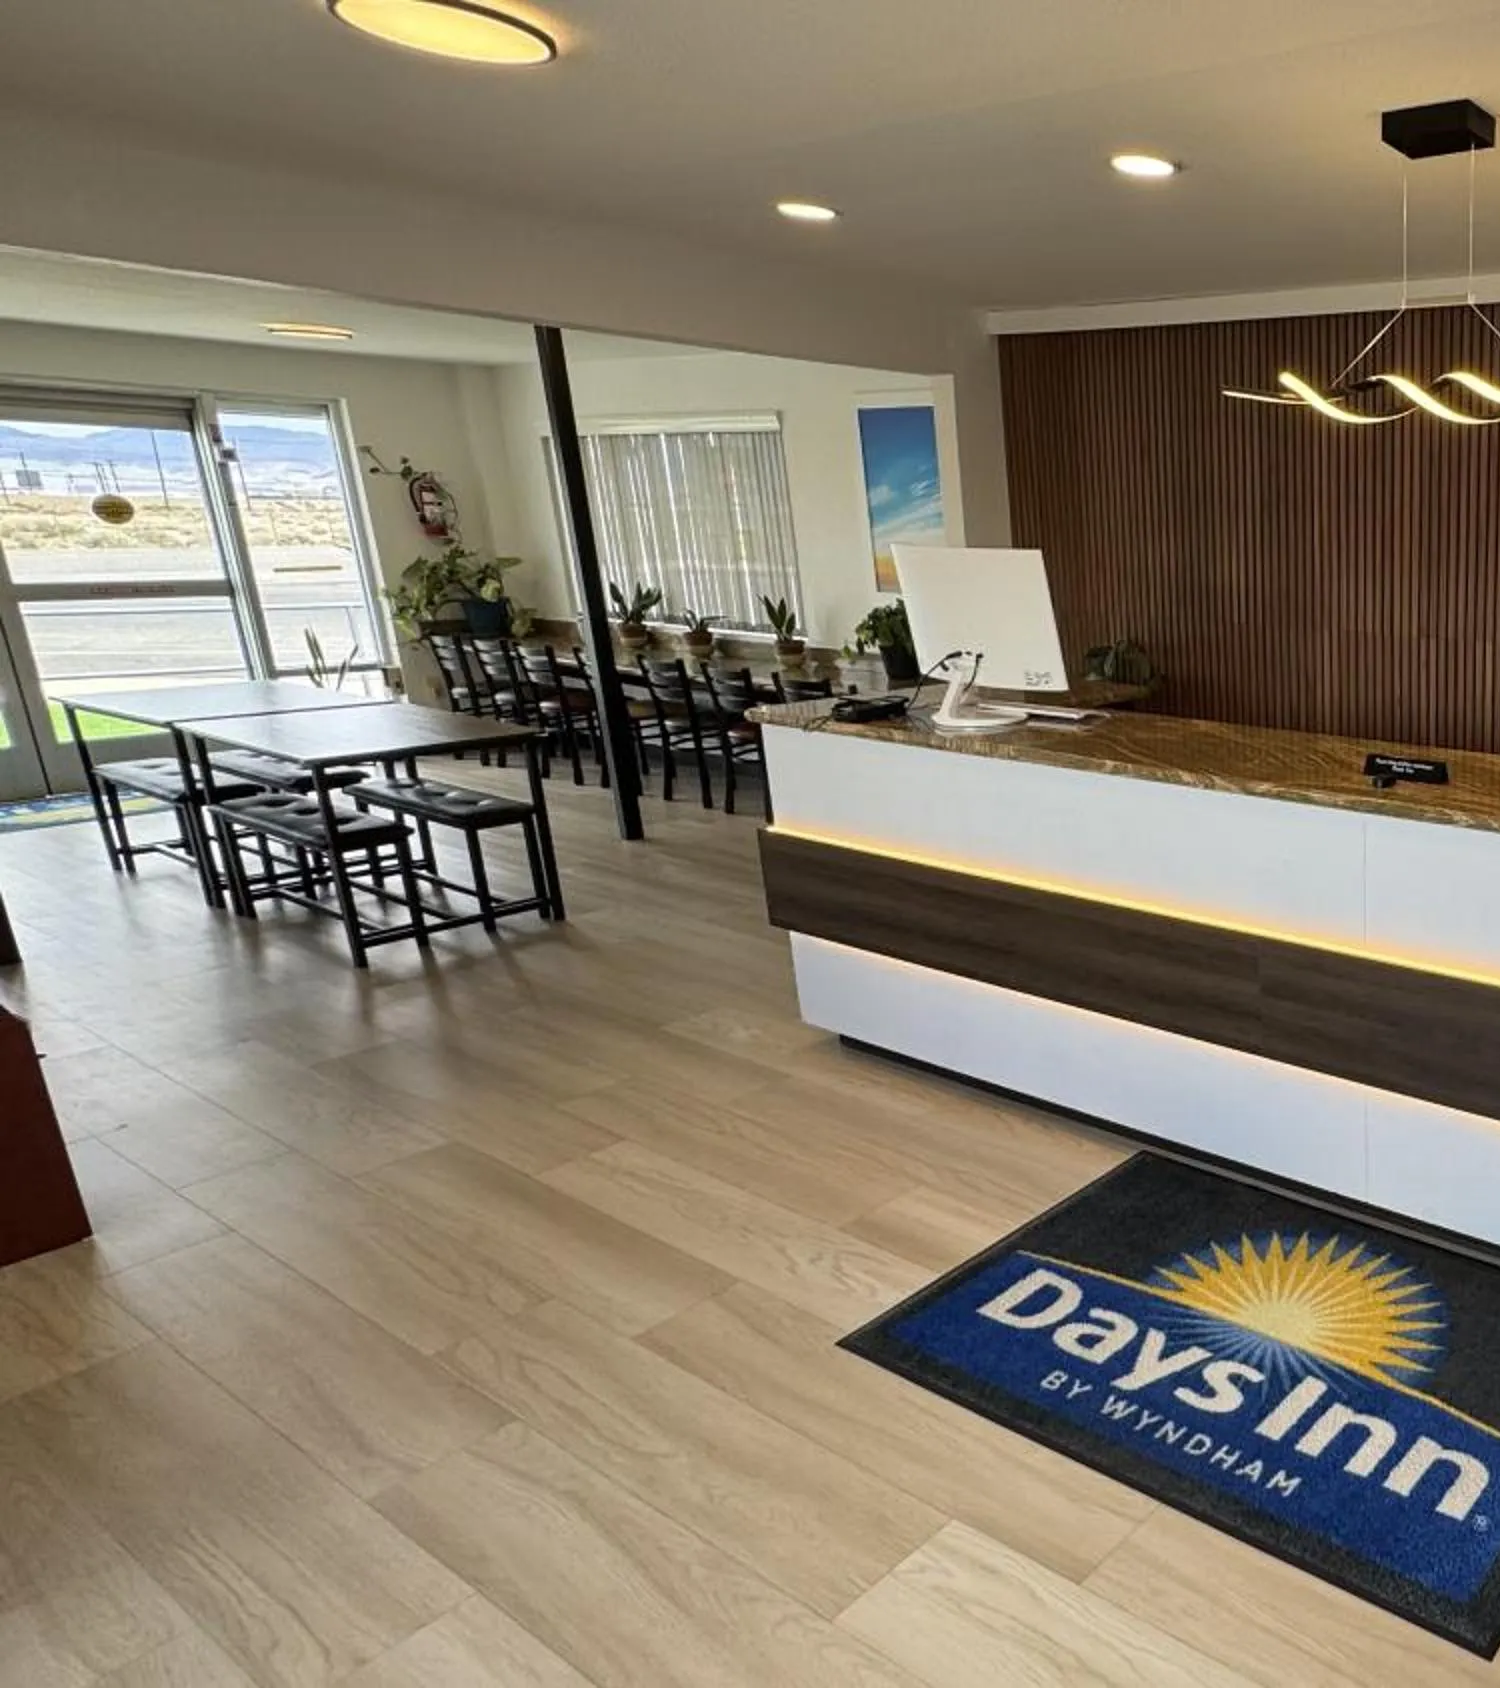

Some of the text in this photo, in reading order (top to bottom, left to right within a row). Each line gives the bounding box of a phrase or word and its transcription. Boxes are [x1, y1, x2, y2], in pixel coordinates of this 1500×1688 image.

[976, 1268, 1490, 1521] Days Inn
[1040, 1370, 1302, 1497] BY WYNDHAM
